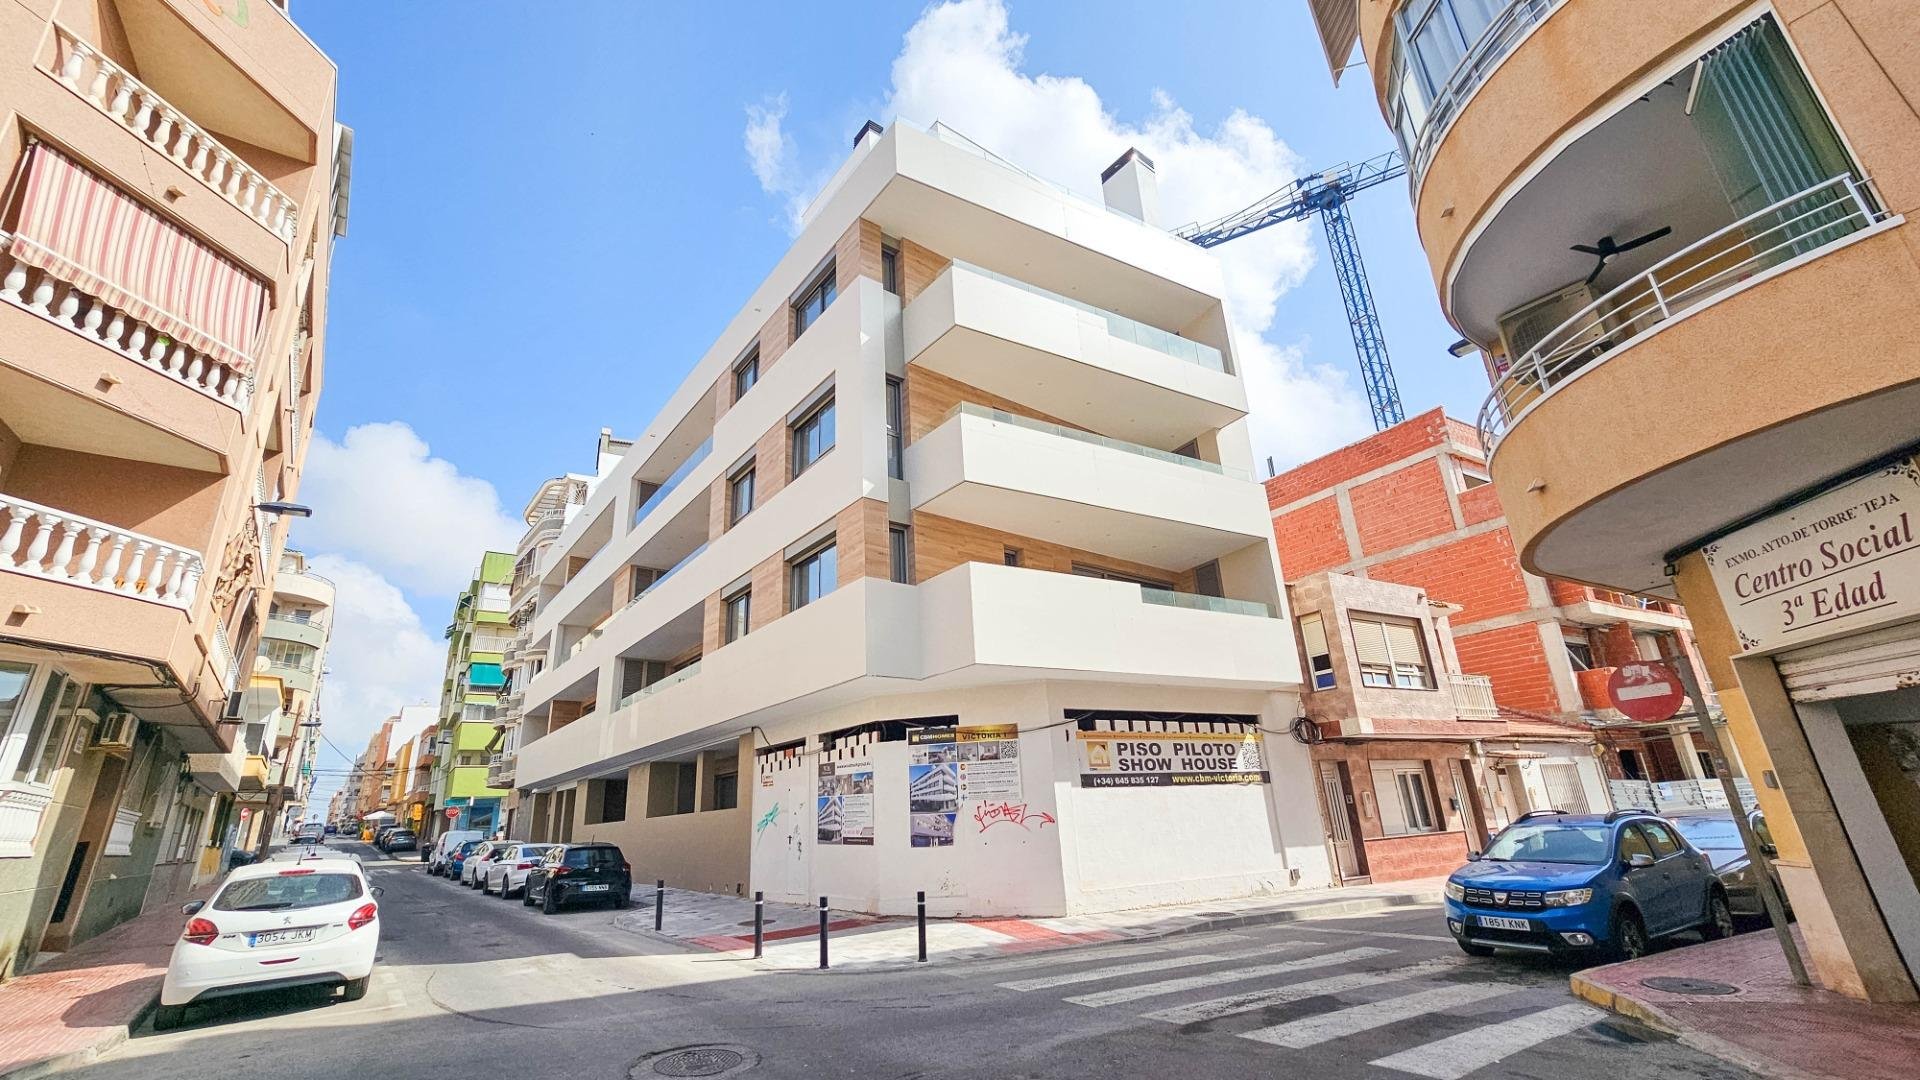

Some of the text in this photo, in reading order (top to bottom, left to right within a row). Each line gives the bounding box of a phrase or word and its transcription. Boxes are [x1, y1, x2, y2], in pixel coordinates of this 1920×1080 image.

[1734, 512, 1914, 598] Centro Social
[1781, 570, 1887, 626] 3ª Edad
[962, 732, 1001, 740] VICTORIA
[1116, 742, 1236, 756] PISO PILOTO
[1118, 758, 1238, 771] SHOW HOUSE
[1093, 776, 1114, 786] (+34)
[1145, 776, 1160, 784] 127
[1171, 773, 1260, 783] www.cbm-victoria.com
[1484, 917, 1528, 929] 1851 KNK
[257, 929, 312, 943] 3054 JKM
